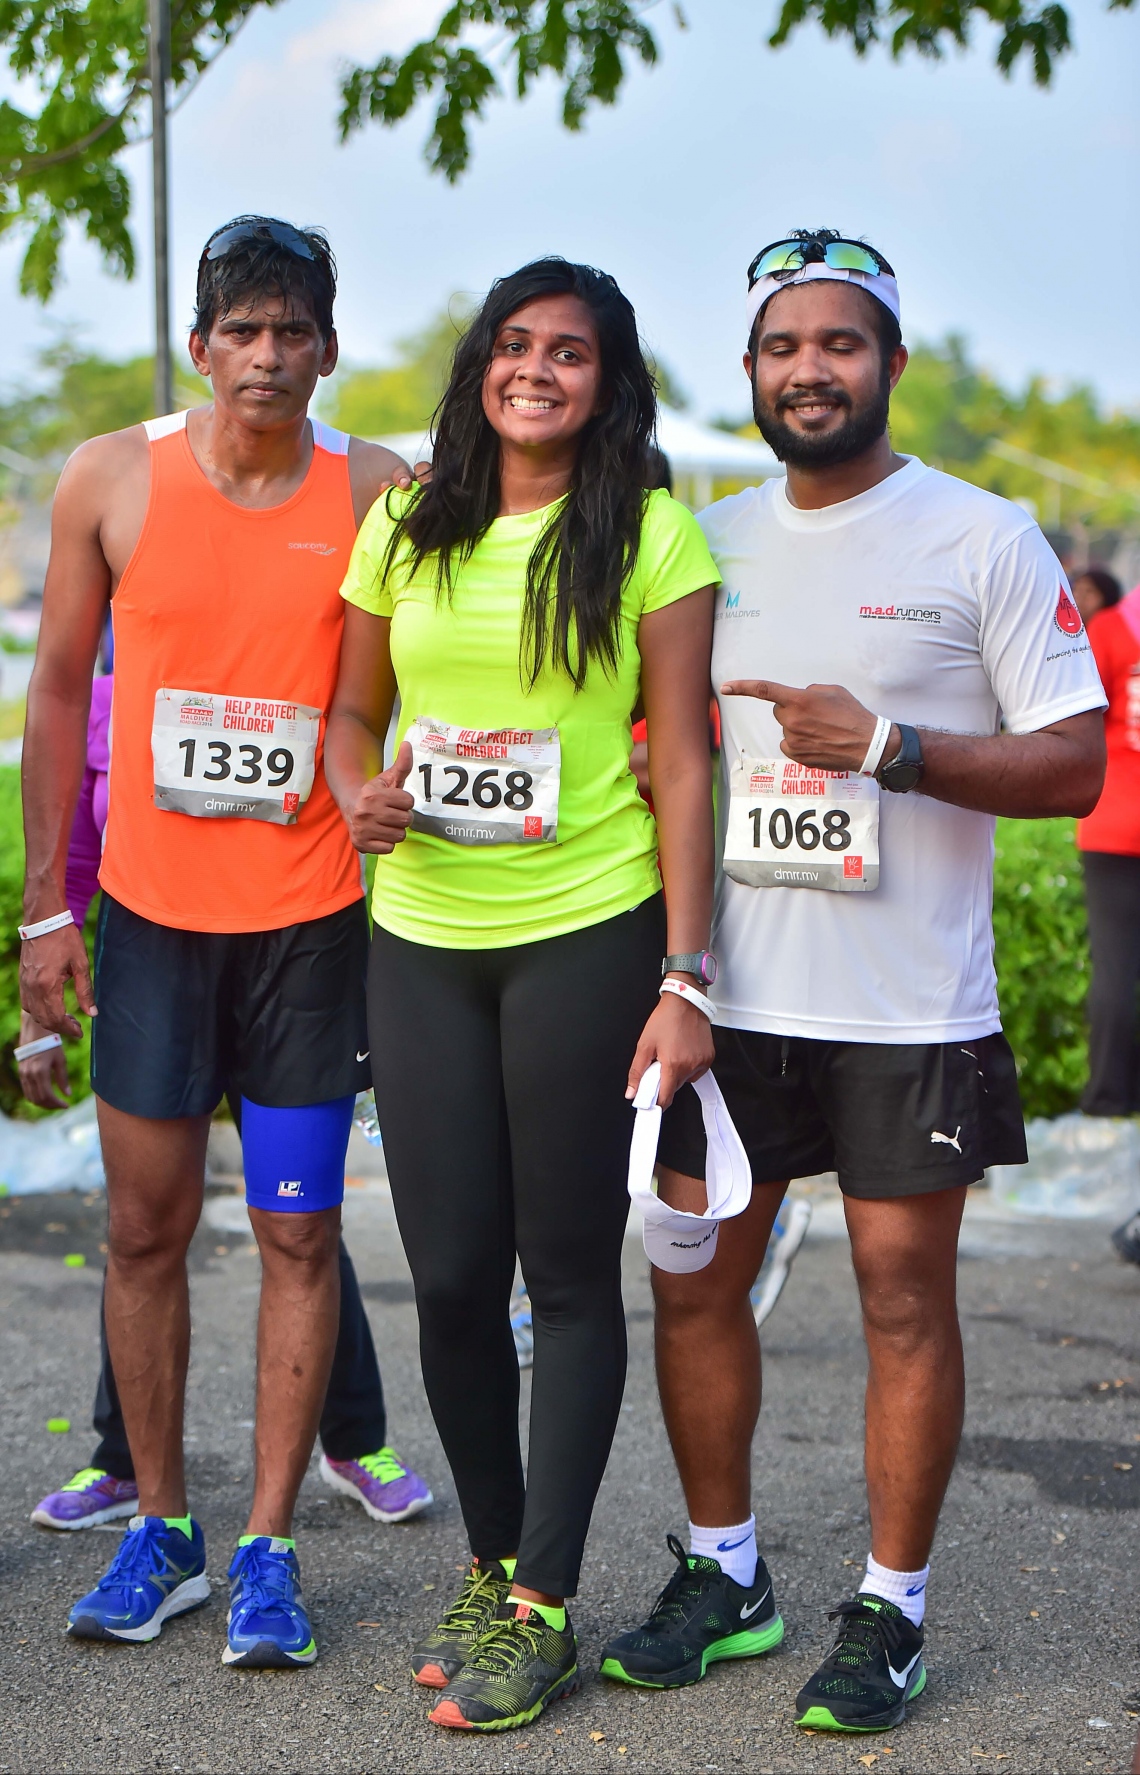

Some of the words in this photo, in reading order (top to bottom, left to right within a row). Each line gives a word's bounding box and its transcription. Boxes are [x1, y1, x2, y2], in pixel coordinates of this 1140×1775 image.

[287, 542, 328, 550] saucony
[725, 609, 761, 619] MALDIVES
[1046, 650, 1072, 662] enhancing
[224, 699, 251, 715] HELP
[254, 701, 298, 720] PROTECT
[180, 714, 213, 723] MALDIVES
[223, 714, 275, 734] CHILDREN
[457, 729, 485, 744] HELP
[485, 730, 534, 745] PROTECT
[455, 743, 508, 759] CHILDREN
[178, 738, 295, 787] 1339
[783, 762, 803, 778] HELP
[418, 763, 534, 811] 1268
[781, 779, 825, 796] CHILDREN
[205, 798, 256, 813] dmrr.mv
[445, 824, 496, 840] dmrr.mv
[748, 807, 852, 852] 1068
[774, 868, 819, 882] dmrr.mv
